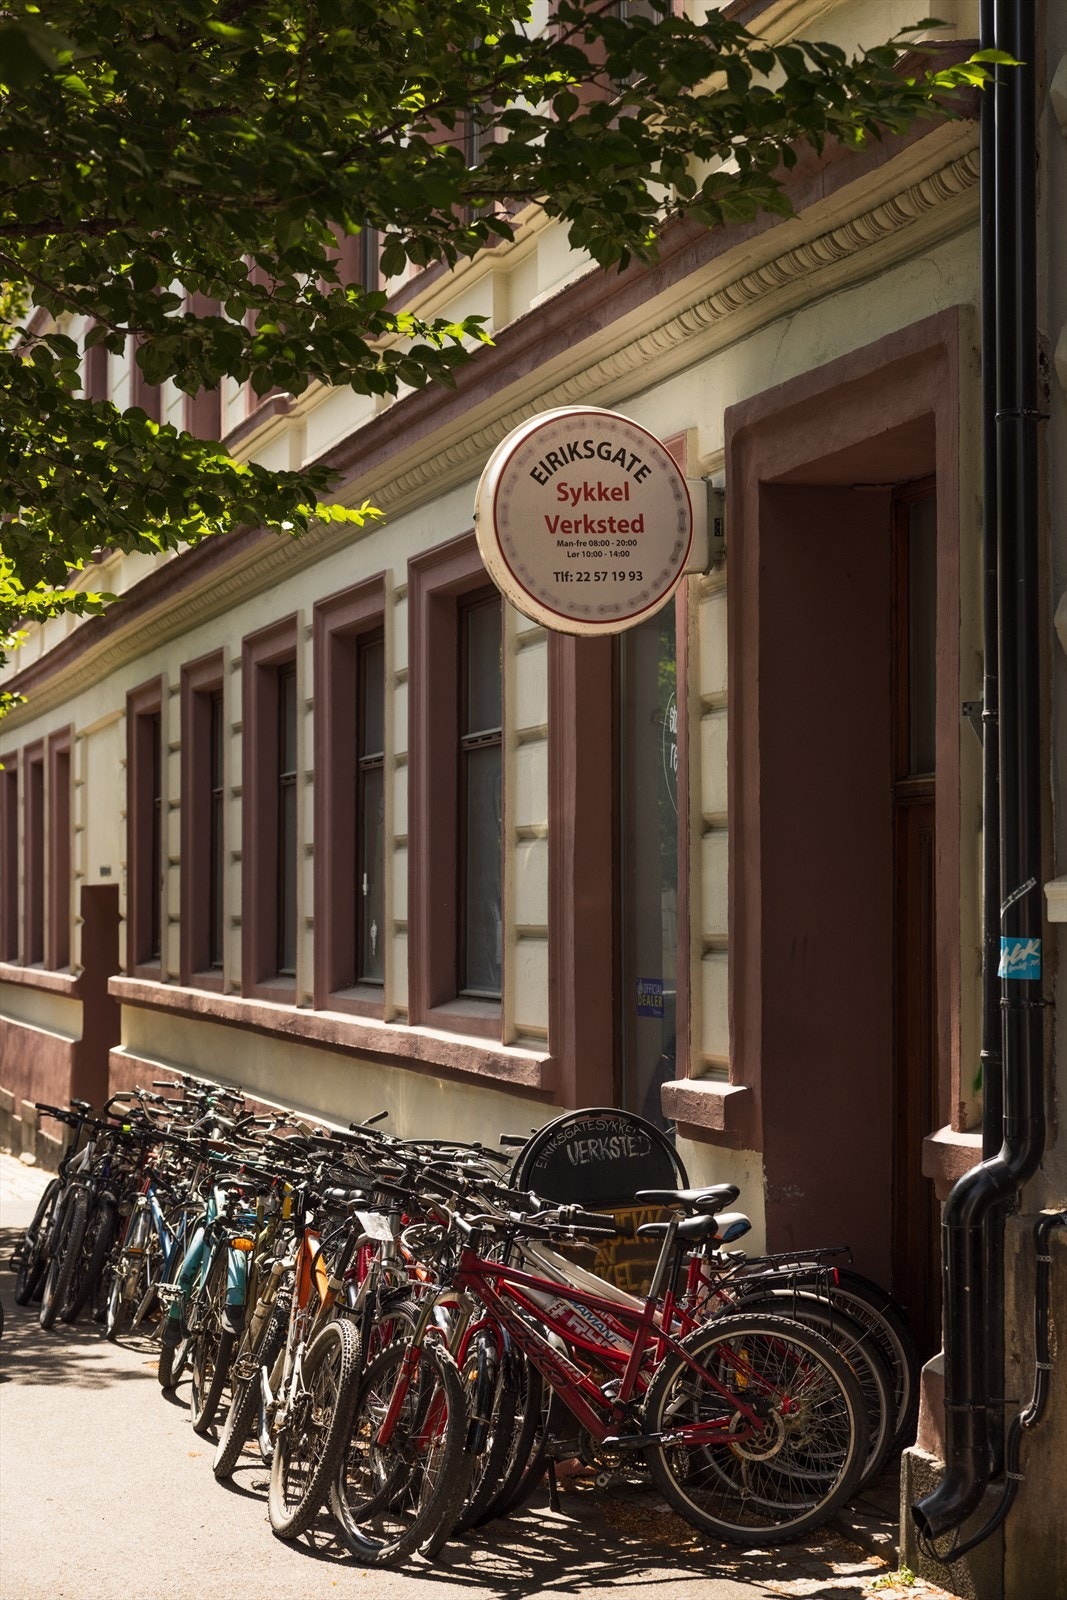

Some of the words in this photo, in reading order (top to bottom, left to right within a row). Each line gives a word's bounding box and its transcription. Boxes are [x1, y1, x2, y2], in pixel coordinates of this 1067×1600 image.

[529, 440, 652, 486] EIRIKSGATE
[557, 481, 630, 507] Sykkel
[544, 514, 644, 534] Verksted
[557, 539, 588, 548] Man-fre
[589, 539, 611, 548] 08:00
[616, 539, 638, 548] 20:00
[609, 550, 630, 558] 14:00
[553, 571, 573, 583] Tlf:
[576, 571, 590, 582] 22
[594, 571, 608, 582] 57
[612, 571, 627, 582] 19
[628, 571, 643, 582] 93
[638, 994, 662, 1007] DEALER
